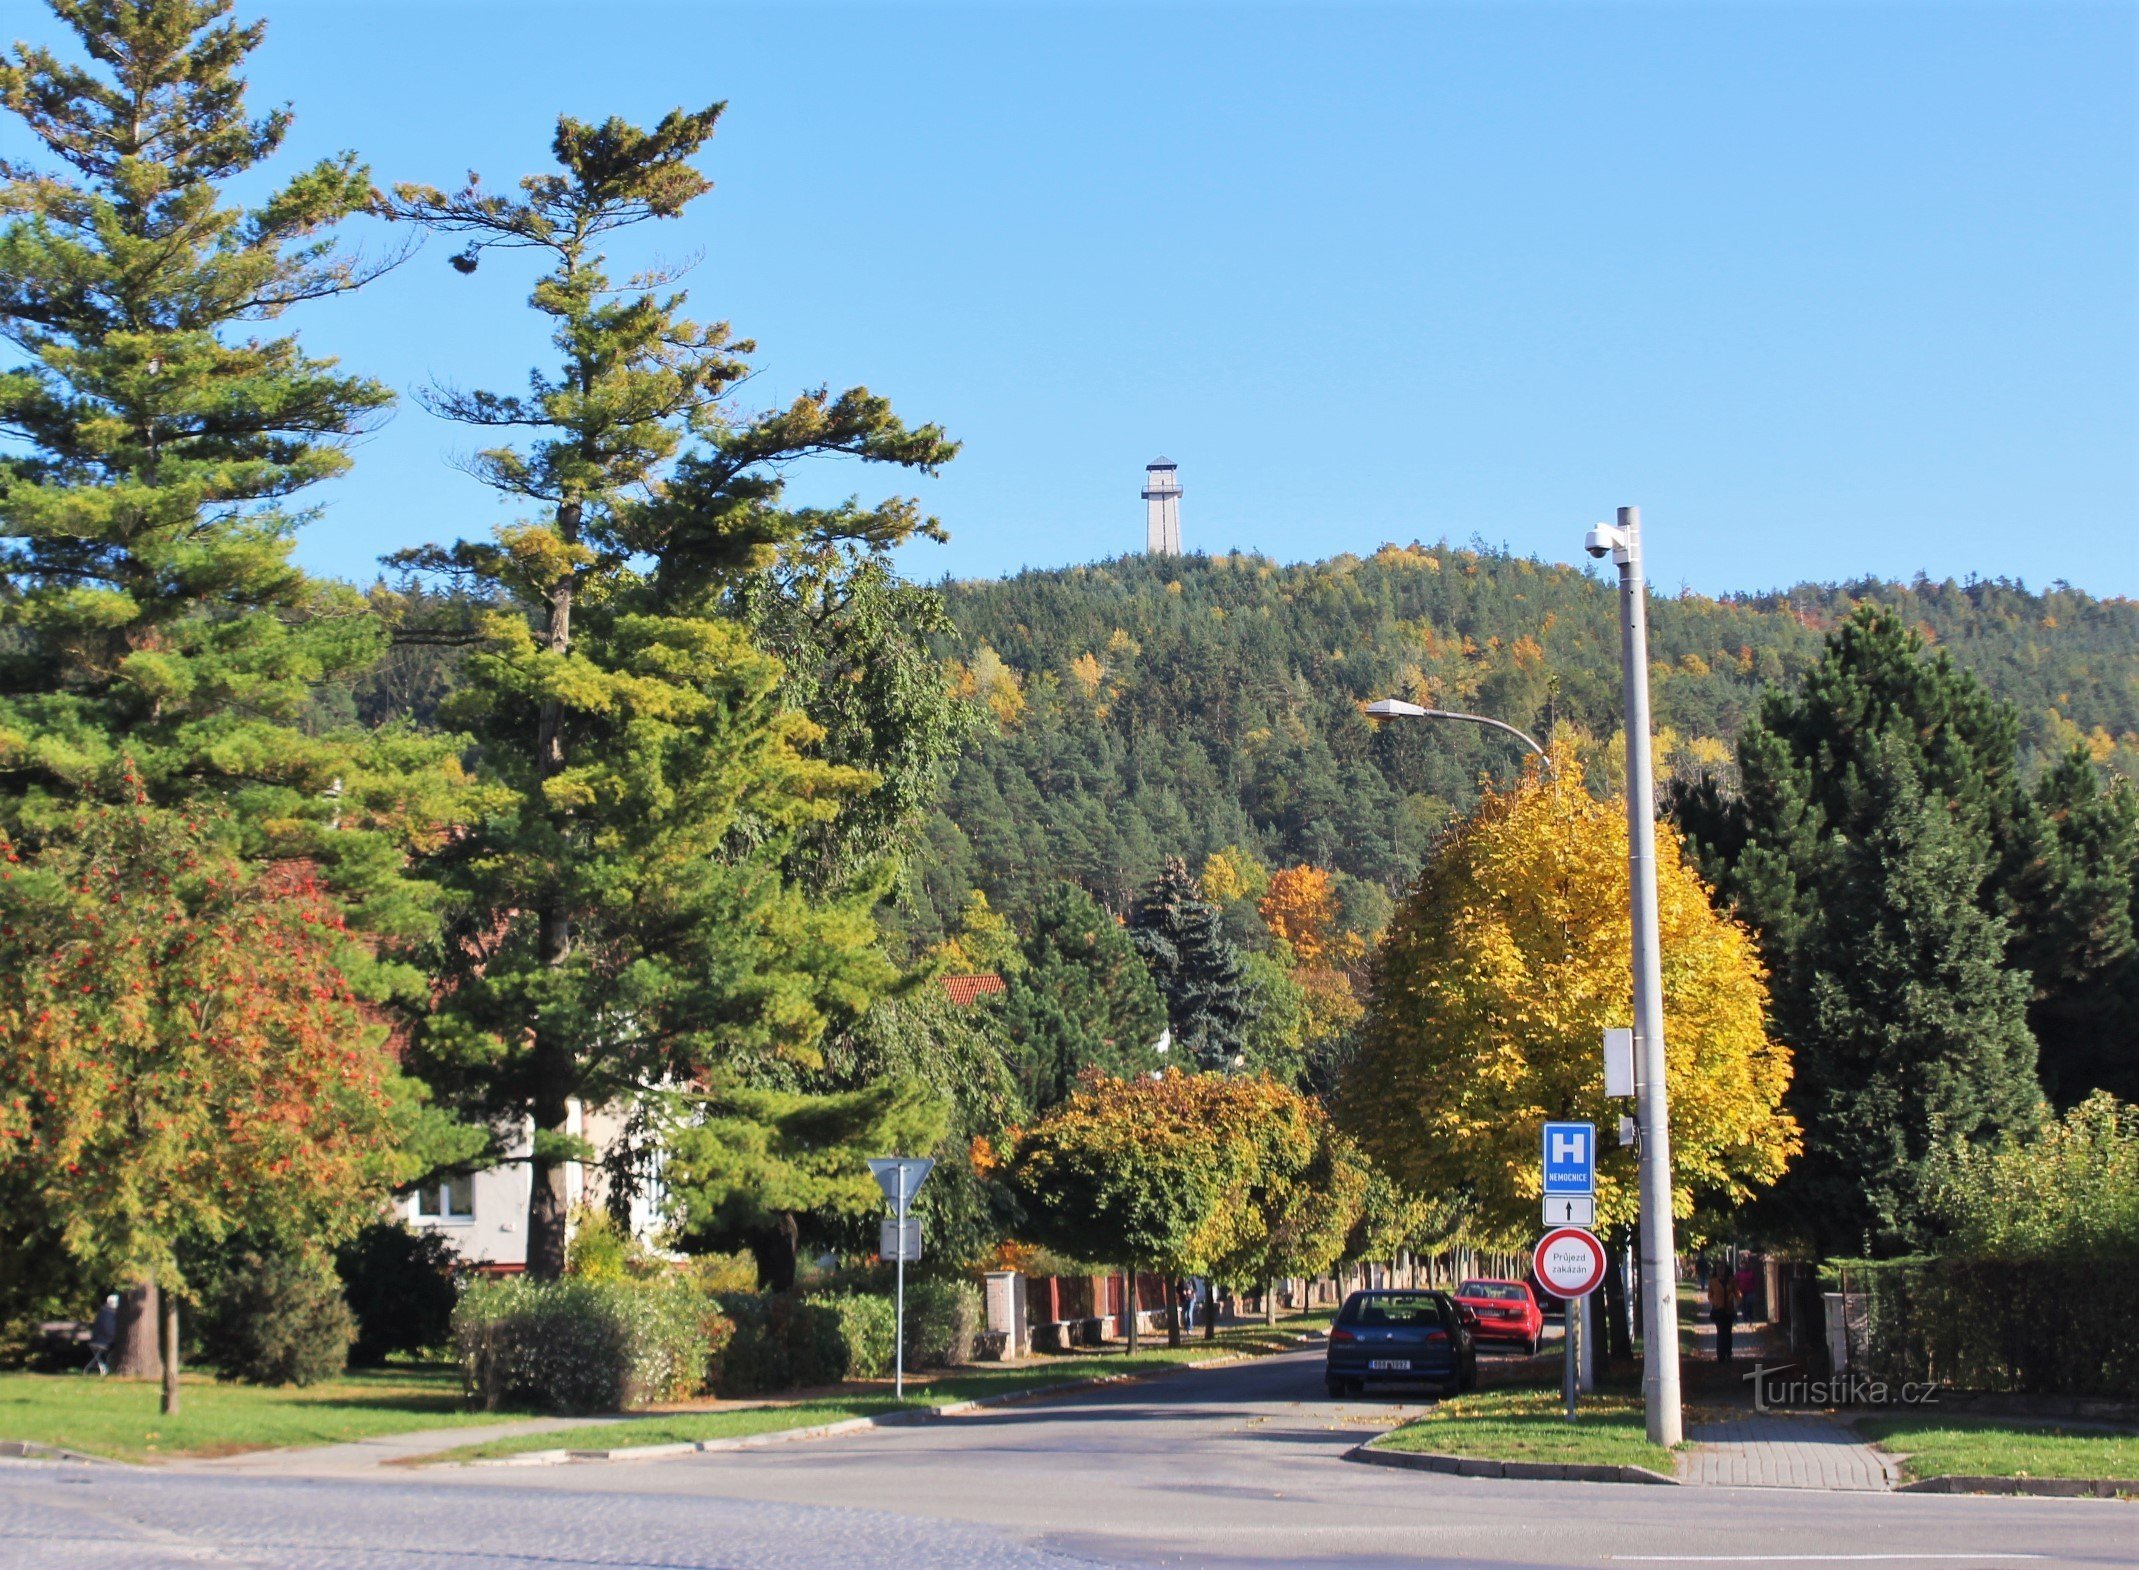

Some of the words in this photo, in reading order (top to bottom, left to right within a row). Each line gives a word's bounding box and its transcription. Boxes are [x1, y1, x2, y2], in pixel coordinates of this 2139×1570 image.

[1553, 1133, 1584, 1163] H
[1549, 1173, 1587, 1182] NEMOCNICE
[1553, 1252, 1586, 1263] Průjezd
[1552, 1265, 1587, 1274] zakázán
